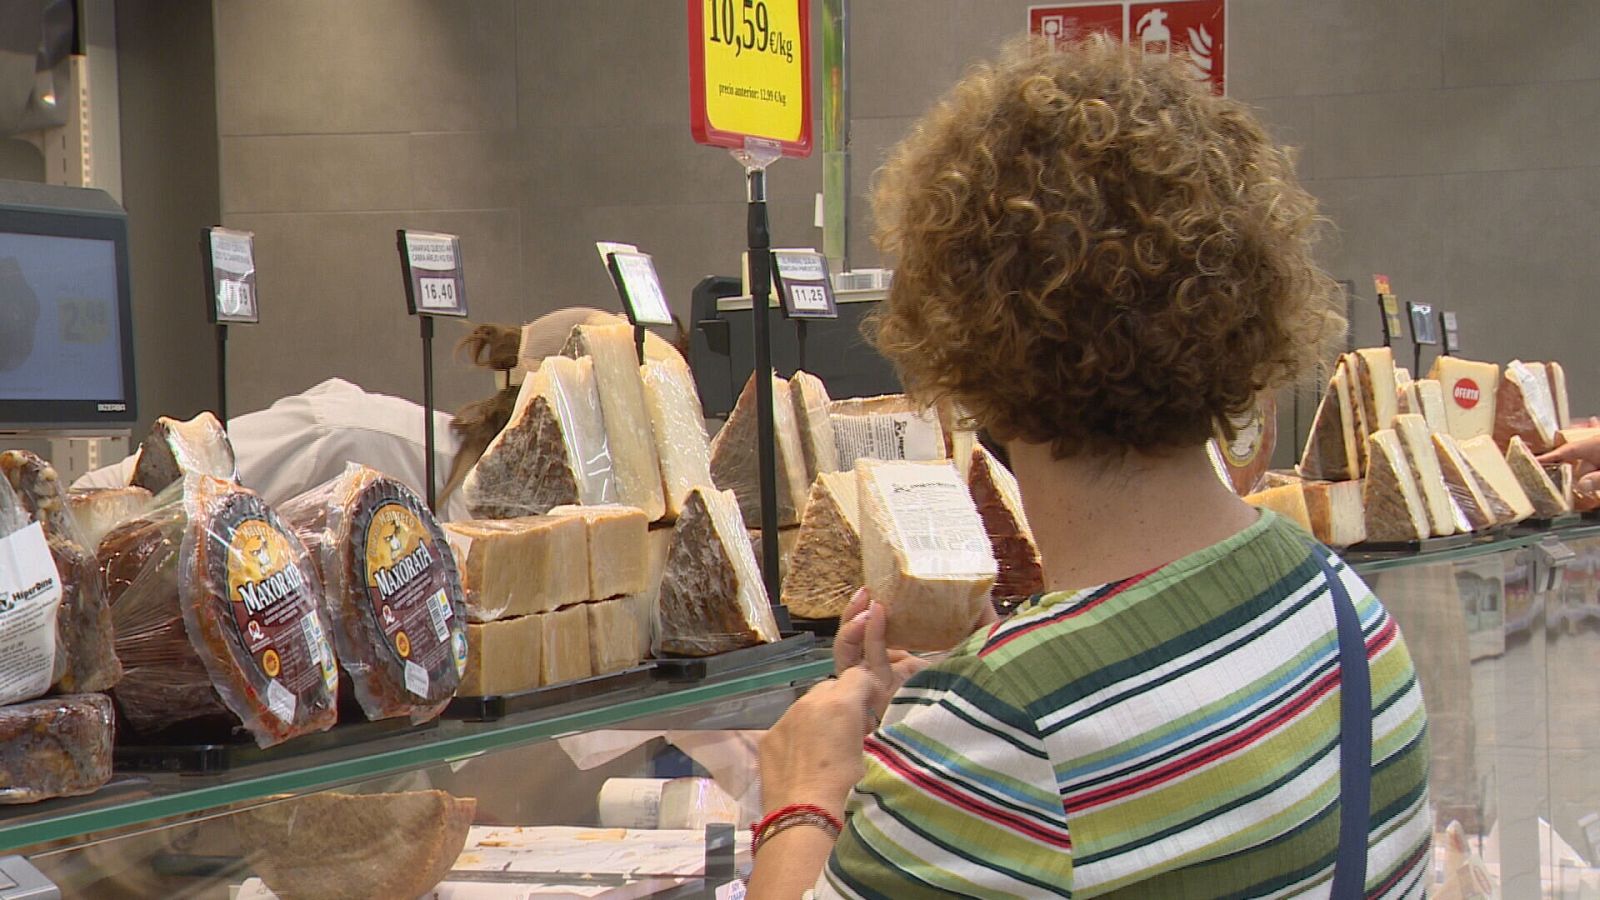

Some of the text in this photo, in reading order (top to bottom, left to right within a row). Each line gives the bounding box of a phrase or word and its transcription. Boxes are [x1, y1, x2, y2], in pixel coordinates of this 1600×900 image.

[719, 83, 734, 96] precio
[425, 283, 453, 301] 16,40
[795, 288, 823, 303] 11,25
[1454, 386, 1479, 401] OFERTA
[374, 537, 433, 600] MAXORATA
[12, 577, 53, 601] HiperDino
